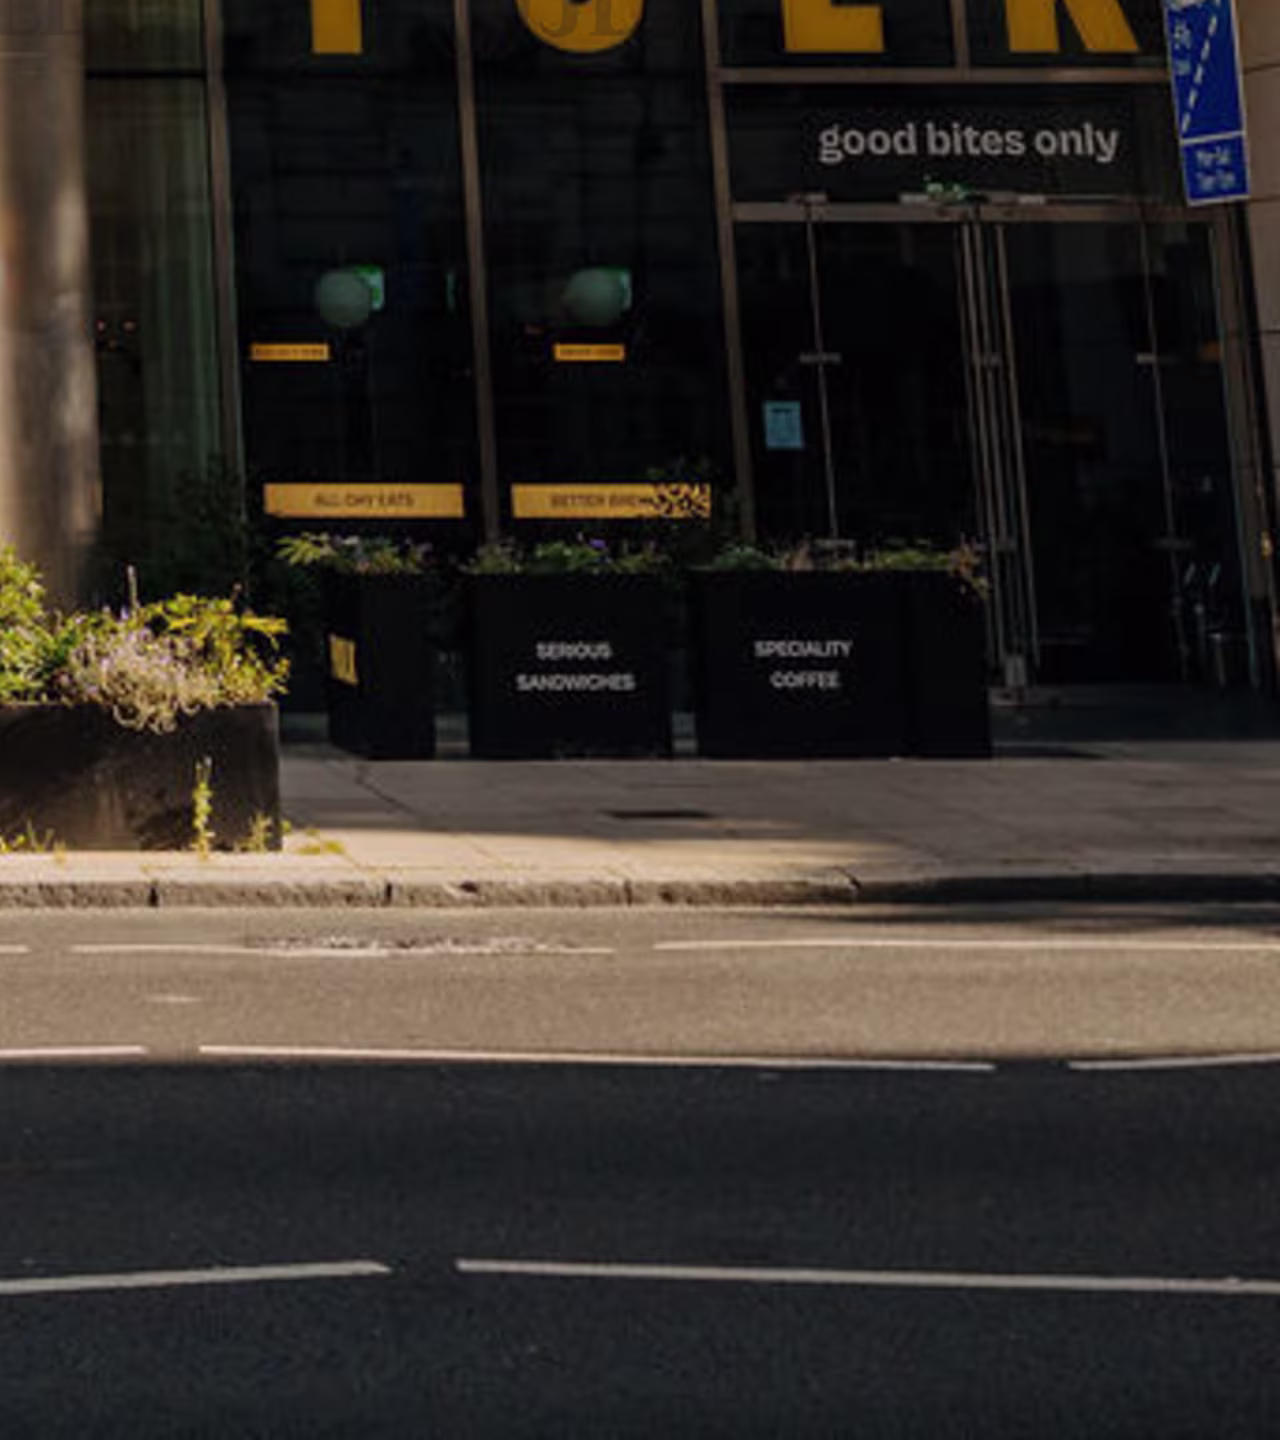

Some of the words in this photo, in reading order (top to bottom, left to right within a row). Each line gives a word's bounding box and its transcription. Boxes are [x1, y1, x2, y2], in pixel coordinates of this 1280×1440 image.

[820, 123, 917, 164] good
[926, 122, 1026, 155] bites
[1035, 122, 1118, 164] only
[536, 641, 612, 660] SERIOUS
[755, 640, 853, 658] SPECIALITY
[516, 674, 636, 692] SANDWICHES
[770, 671, 839, 689] COFFEE
